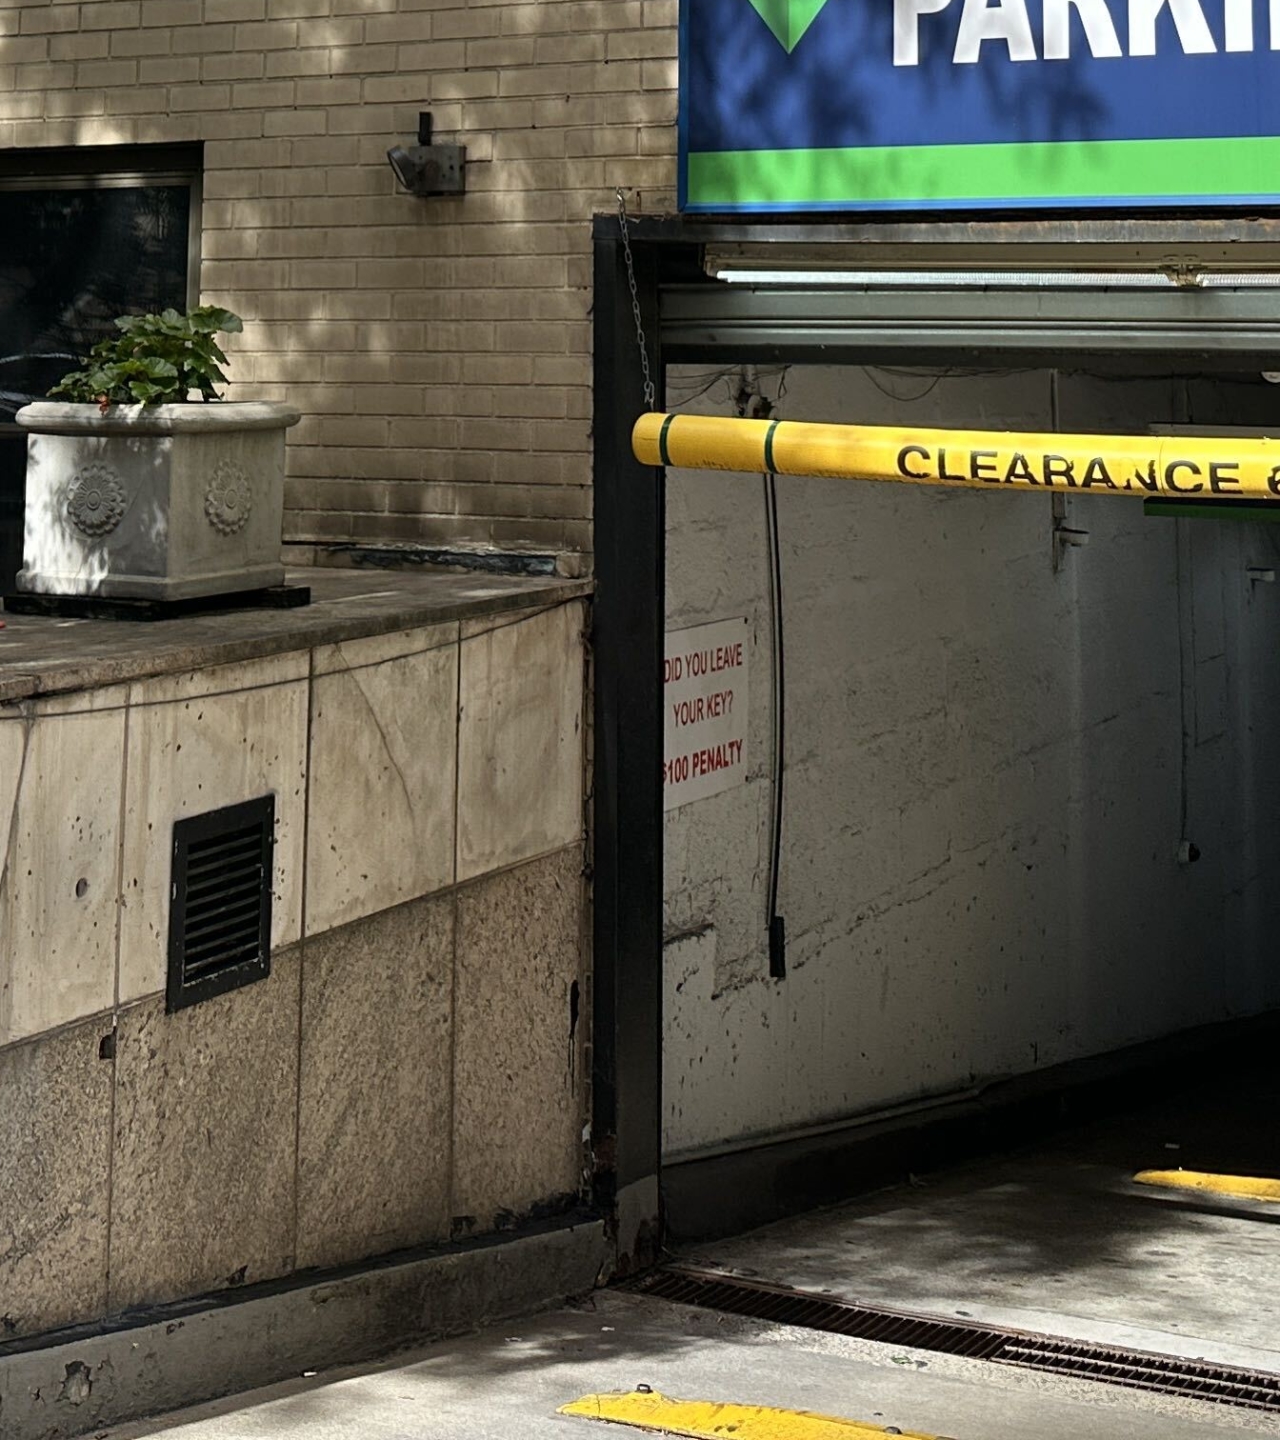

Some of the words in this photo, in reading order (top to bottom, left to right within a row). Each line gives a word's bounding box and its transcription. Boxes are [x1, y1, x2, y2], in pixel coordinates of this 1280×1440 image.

[897, 445, 1245, 496] CLEARANCE
[664, 657, 683, 683] DID
[685, 650, 708, 678] YOU
[710, 643, 743, 672] LEAVE
[673, 698, 704, 727] YOUR
[706, 690, 733, 719] KEY?
[692, 739, 743, 778] PENALTY
